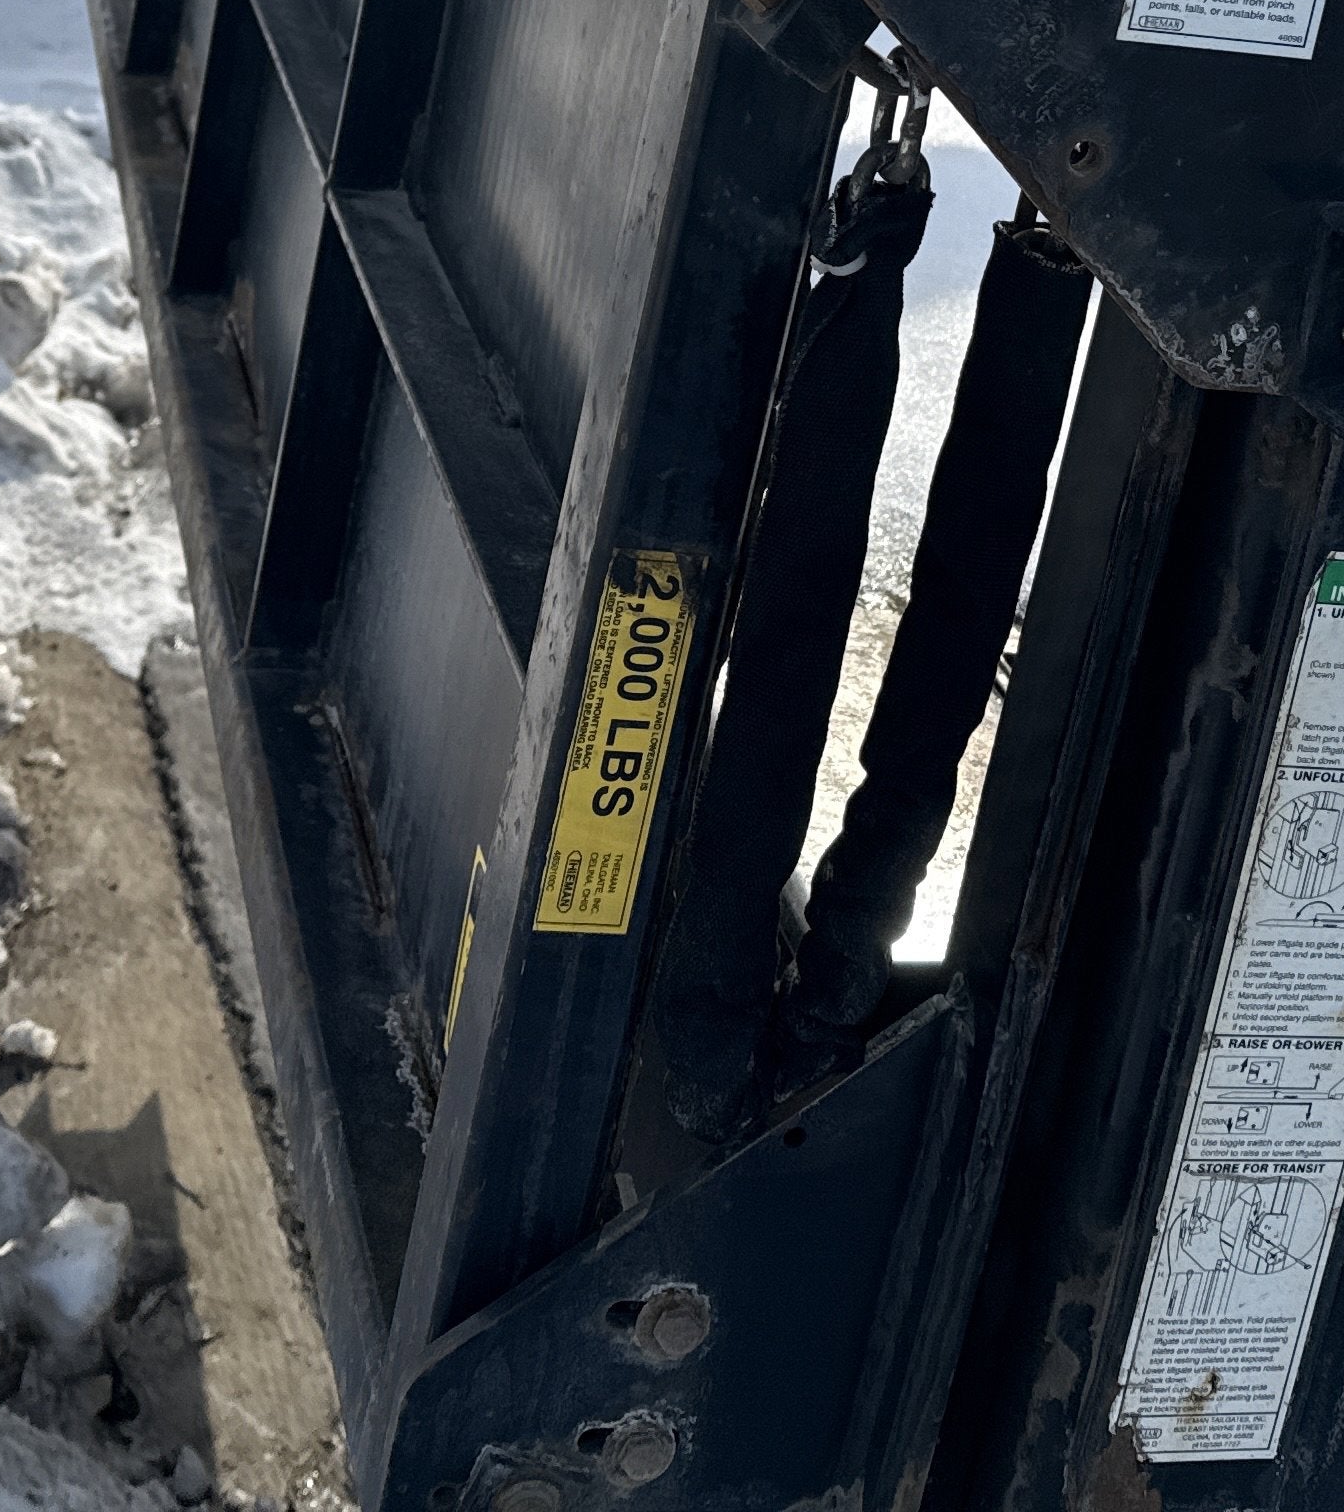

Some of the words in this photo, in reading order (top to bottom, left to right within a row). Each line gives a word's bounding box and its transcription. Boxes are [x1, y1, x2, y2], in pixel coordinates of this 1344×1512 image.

[1147, 0, 1182, 12] points,
[1222, 8, 1265, 20] unstable
[1266, 11, 1297, 24] loads.
[1266, 0, 1295, 10] pinch
[605, 591, 616, 612] SIDE
[612, 600, 625, 625] LOAD
[1316, 606, 1327, 617] 1.
[616, 573, 680, 701] 2,000
[667, 621, 684, 666] CAPACITY
[598, 639, 616, 689] CENTERED
[586, 675, 598, 700] LOAD
[657, 673, 672, 708] LIFTING
[576, 702, 593, 744] BEARING
[590, 696, 604, 728] FRONT
[653, 710, 664, 730] AND
[570, 746, 583, 772] AREA
[580, 743, 594, 769] BACK
[590, 719, 649, 816] LBS
[641, 731, 659, 780] LOWERING
[1276, 769, 1289, 780] 2.
[559, 858, 580, 906] THIEMAN
[607, 853, 623, 893] THIEMAN
[1211, 1037, 1224, 1048] 3.
[1227, 1038, 1268, 1049] RAISE
[1294, 1039, 1343, 1050] LOWER
